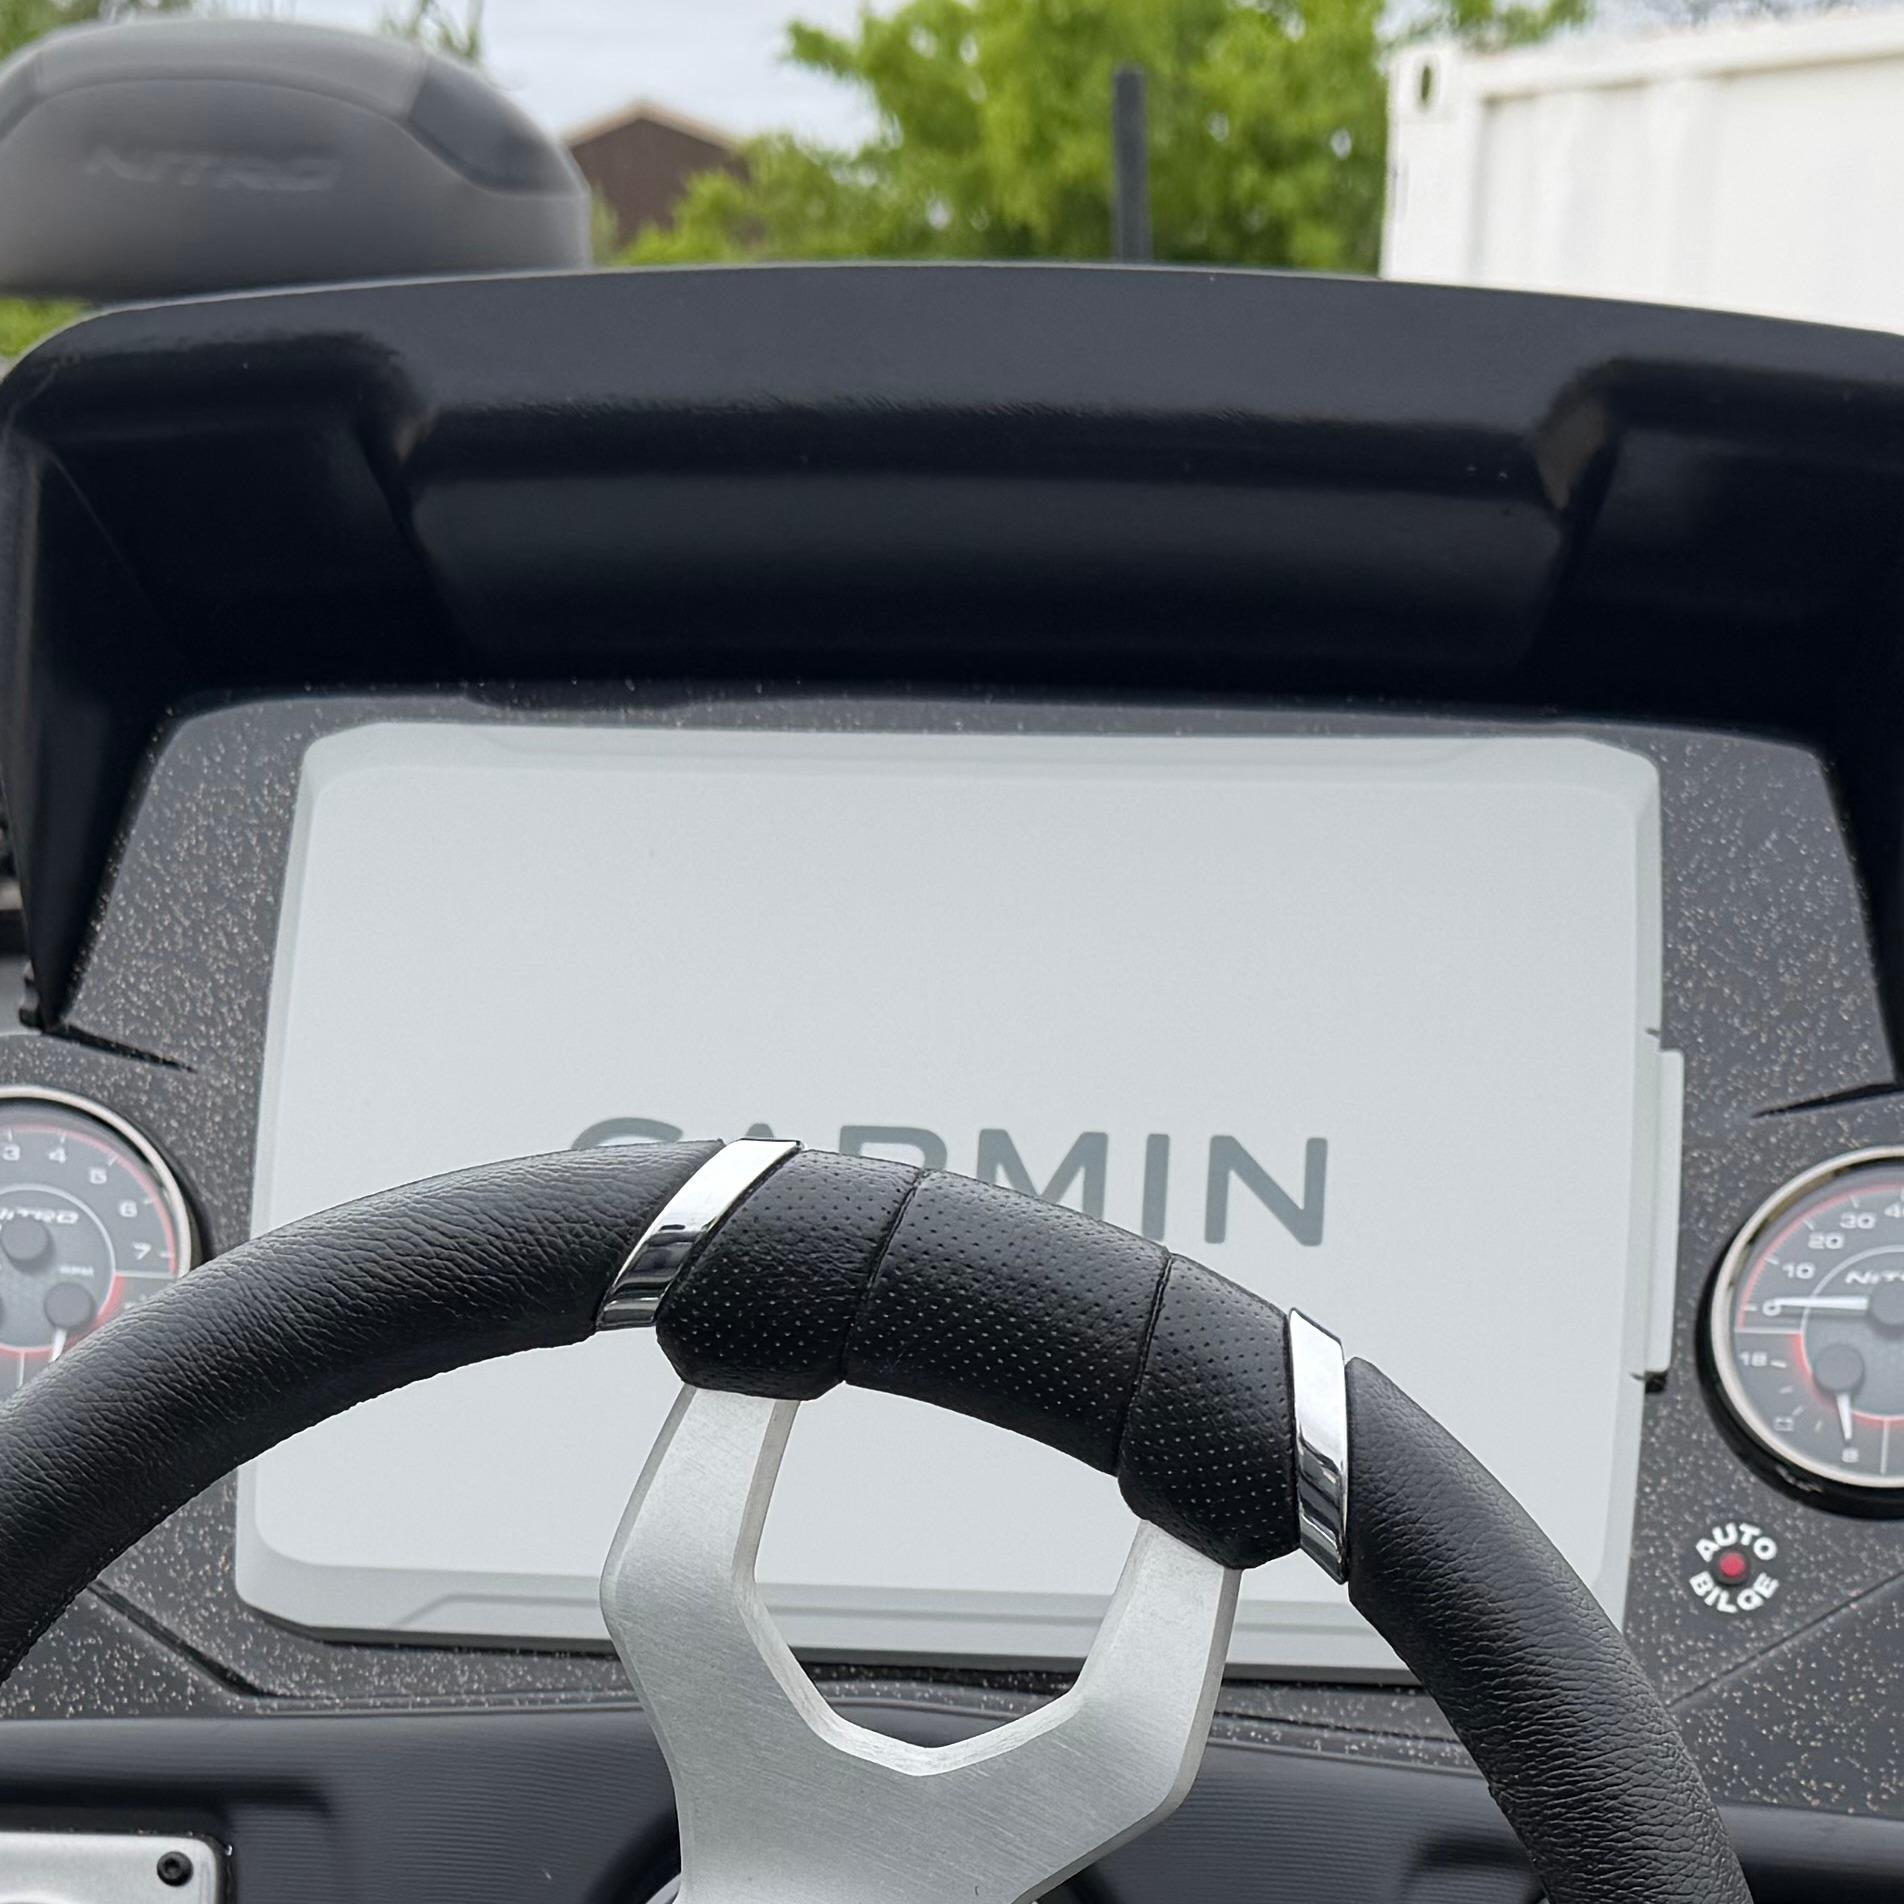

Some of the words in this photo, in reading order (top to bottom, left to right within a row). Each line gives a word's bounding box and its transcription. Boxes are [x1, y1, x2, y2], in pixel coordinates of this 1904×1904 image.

[2, 1145, 20, 1161] 3
[49, 1147, 67, 1164] 4
[90, 1168, 107, 1185] 5
[572, 1117, 1328, 1247] MIN
[120, 1201, 137, 1217] 6
[1840, 1212, 1877, 1229] 30
[1808, 1232, 1845, 1250] 20
[133, 1242, 153, 1261] 7
[1782, 1262, 1816, 1279] 10
[1695, 1522, 1778, 1563] AUTO
[1689, 1571, 1780, 1613] BILGE
